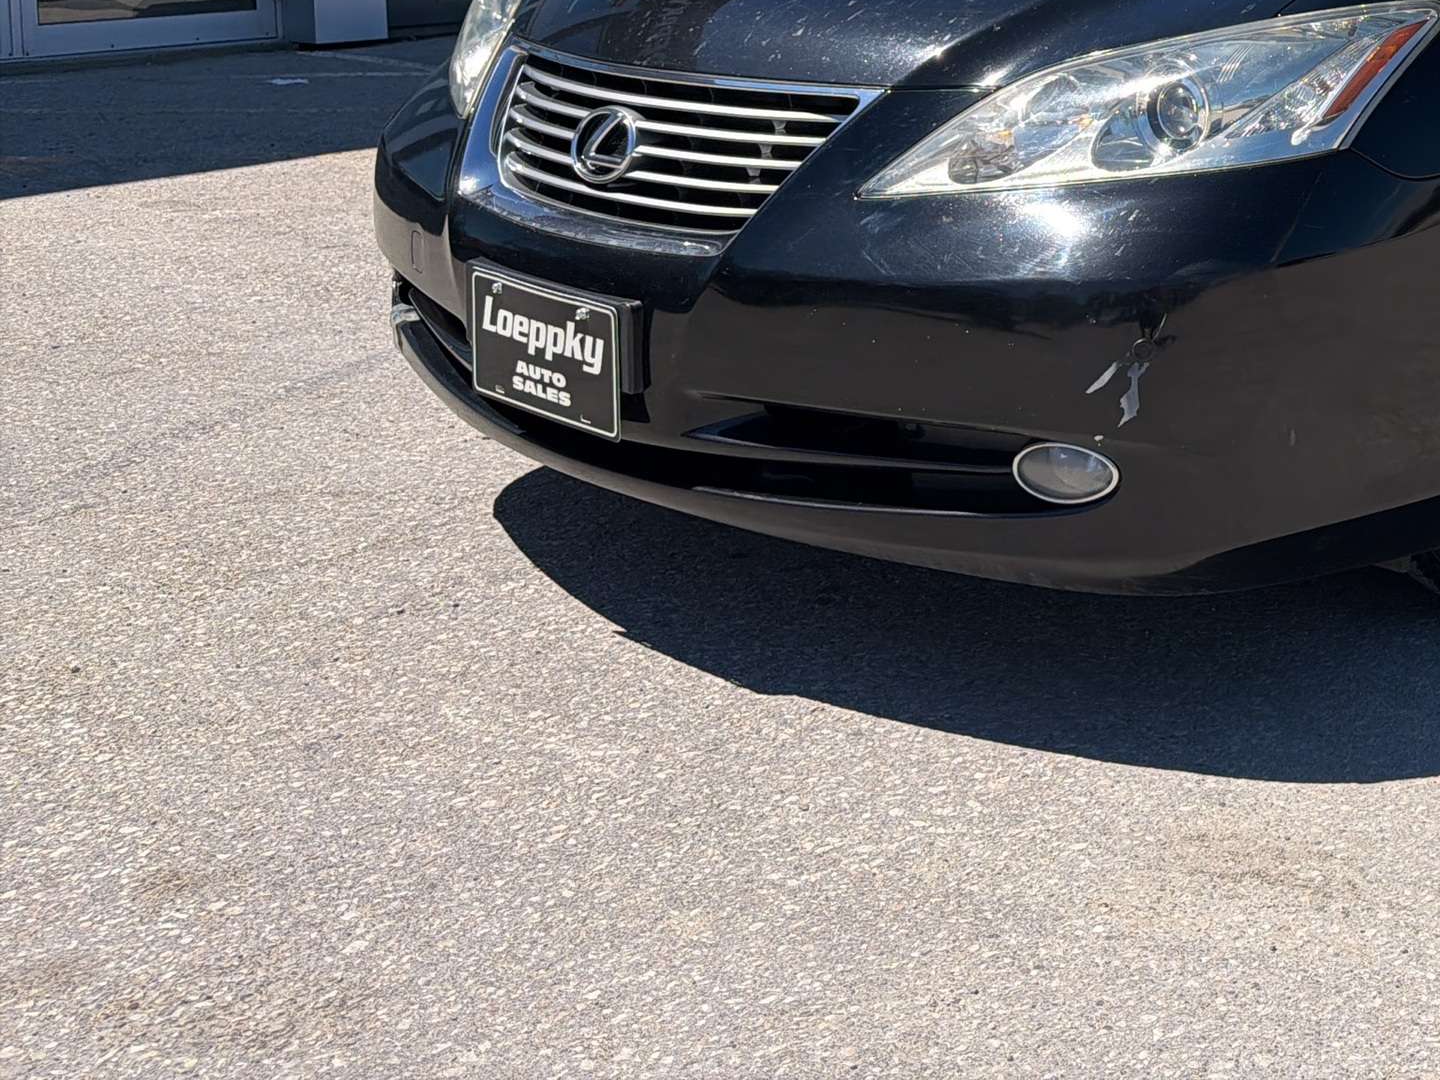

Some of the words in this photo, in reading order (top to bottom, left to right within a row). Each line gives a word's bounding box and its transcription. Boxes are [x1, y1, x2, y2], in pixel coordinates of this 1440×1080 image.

[482, 295, 604, 376] Loeppky
[515, 360, 567, 388] AUTO
[512, 375, 572, 407] SALES
